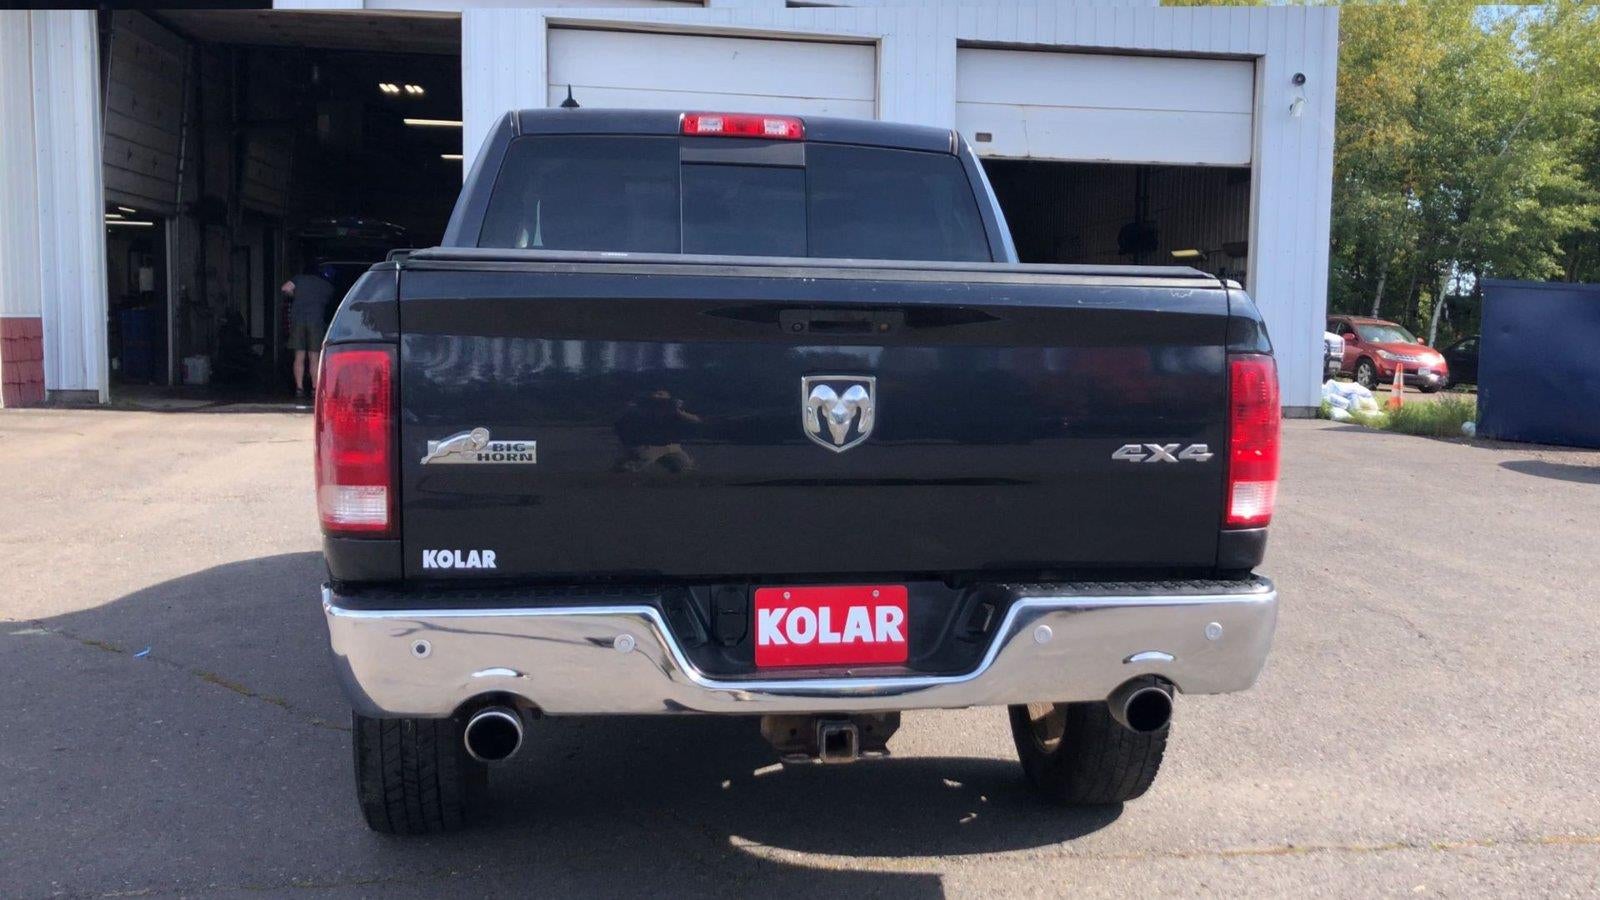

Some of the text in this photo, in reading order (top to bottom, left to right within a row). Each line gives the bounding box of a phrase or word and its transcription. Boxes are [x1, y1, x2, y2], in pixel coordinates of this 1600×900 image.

[477, 453, 533, 462] HORN
[492, 443, 526, 452] BIG
[1111, 443, 1214, 463] 4X4
[422, 549, 497, 569] KOLAR
[758, 605, 905, 646] KOLAR
